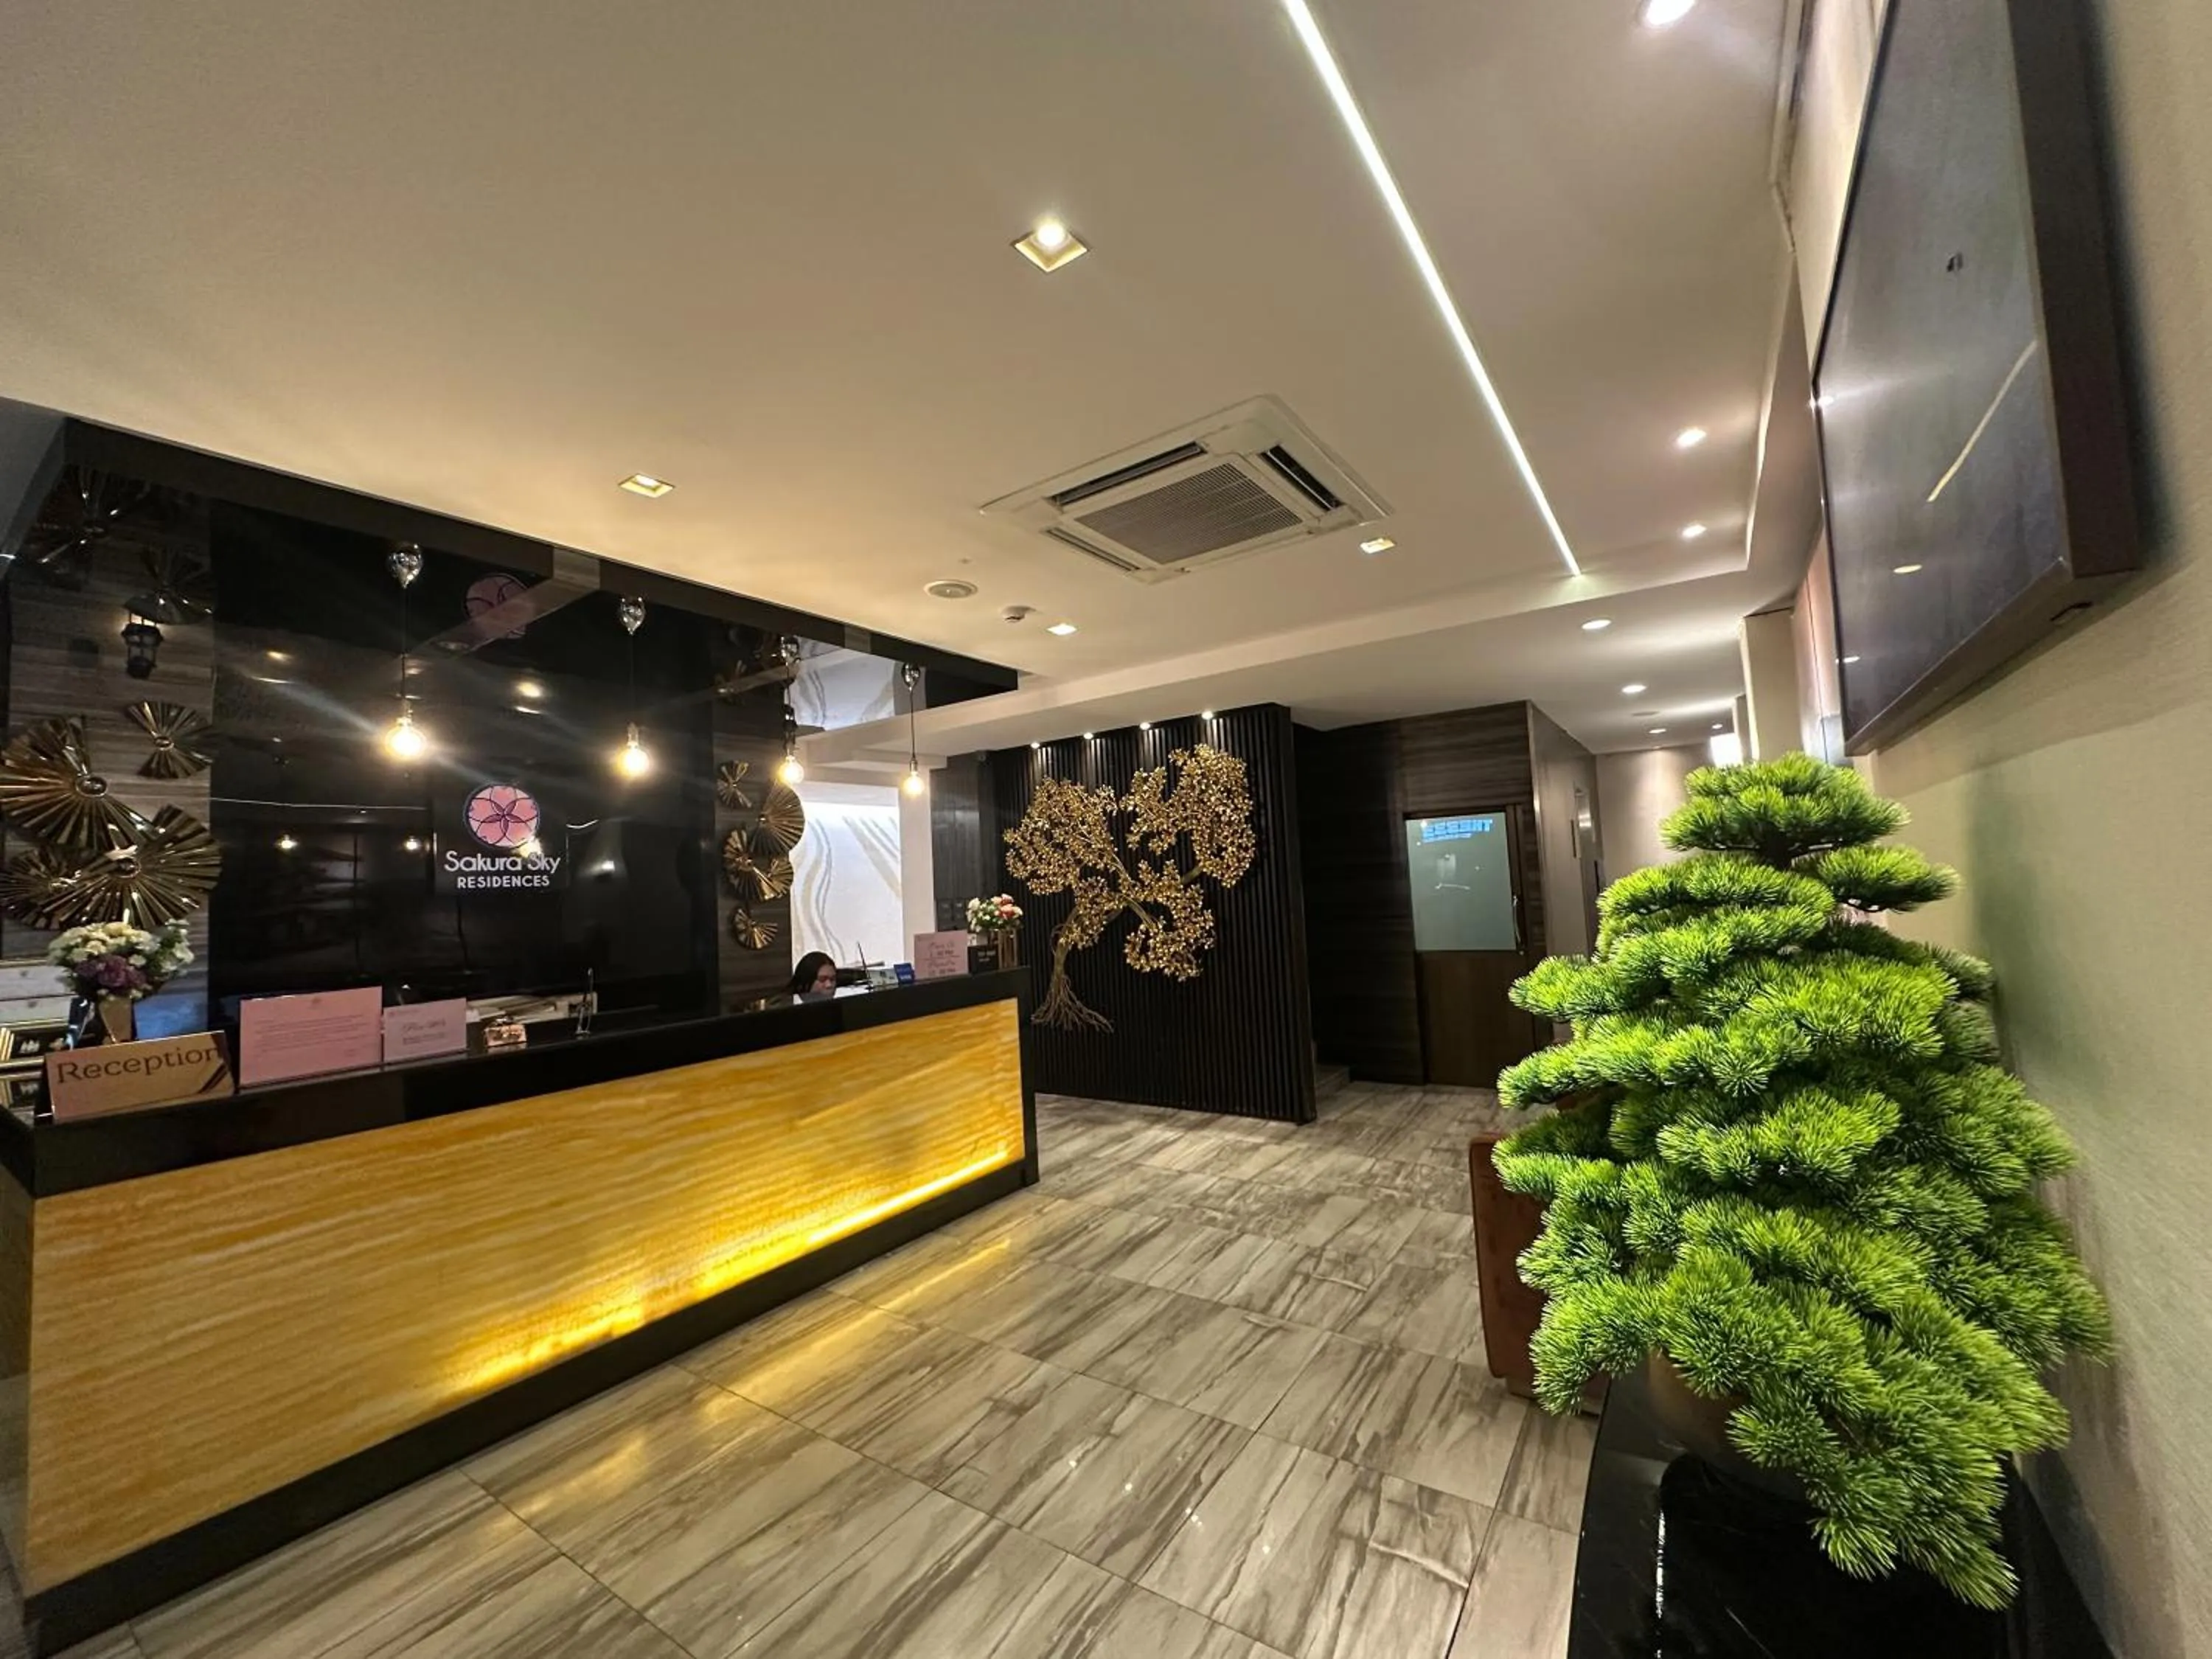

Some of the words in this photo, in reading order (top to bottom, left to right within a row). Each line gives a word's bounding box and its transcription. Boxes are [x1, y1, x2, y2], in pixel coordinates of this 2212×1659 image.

[445, 850, 522, 872] Sakura
[527, 852, 560, 874] Sky
[457, 875, 550, 888] RESIDENCES
[57, 1046, 222, 1083] Reception
